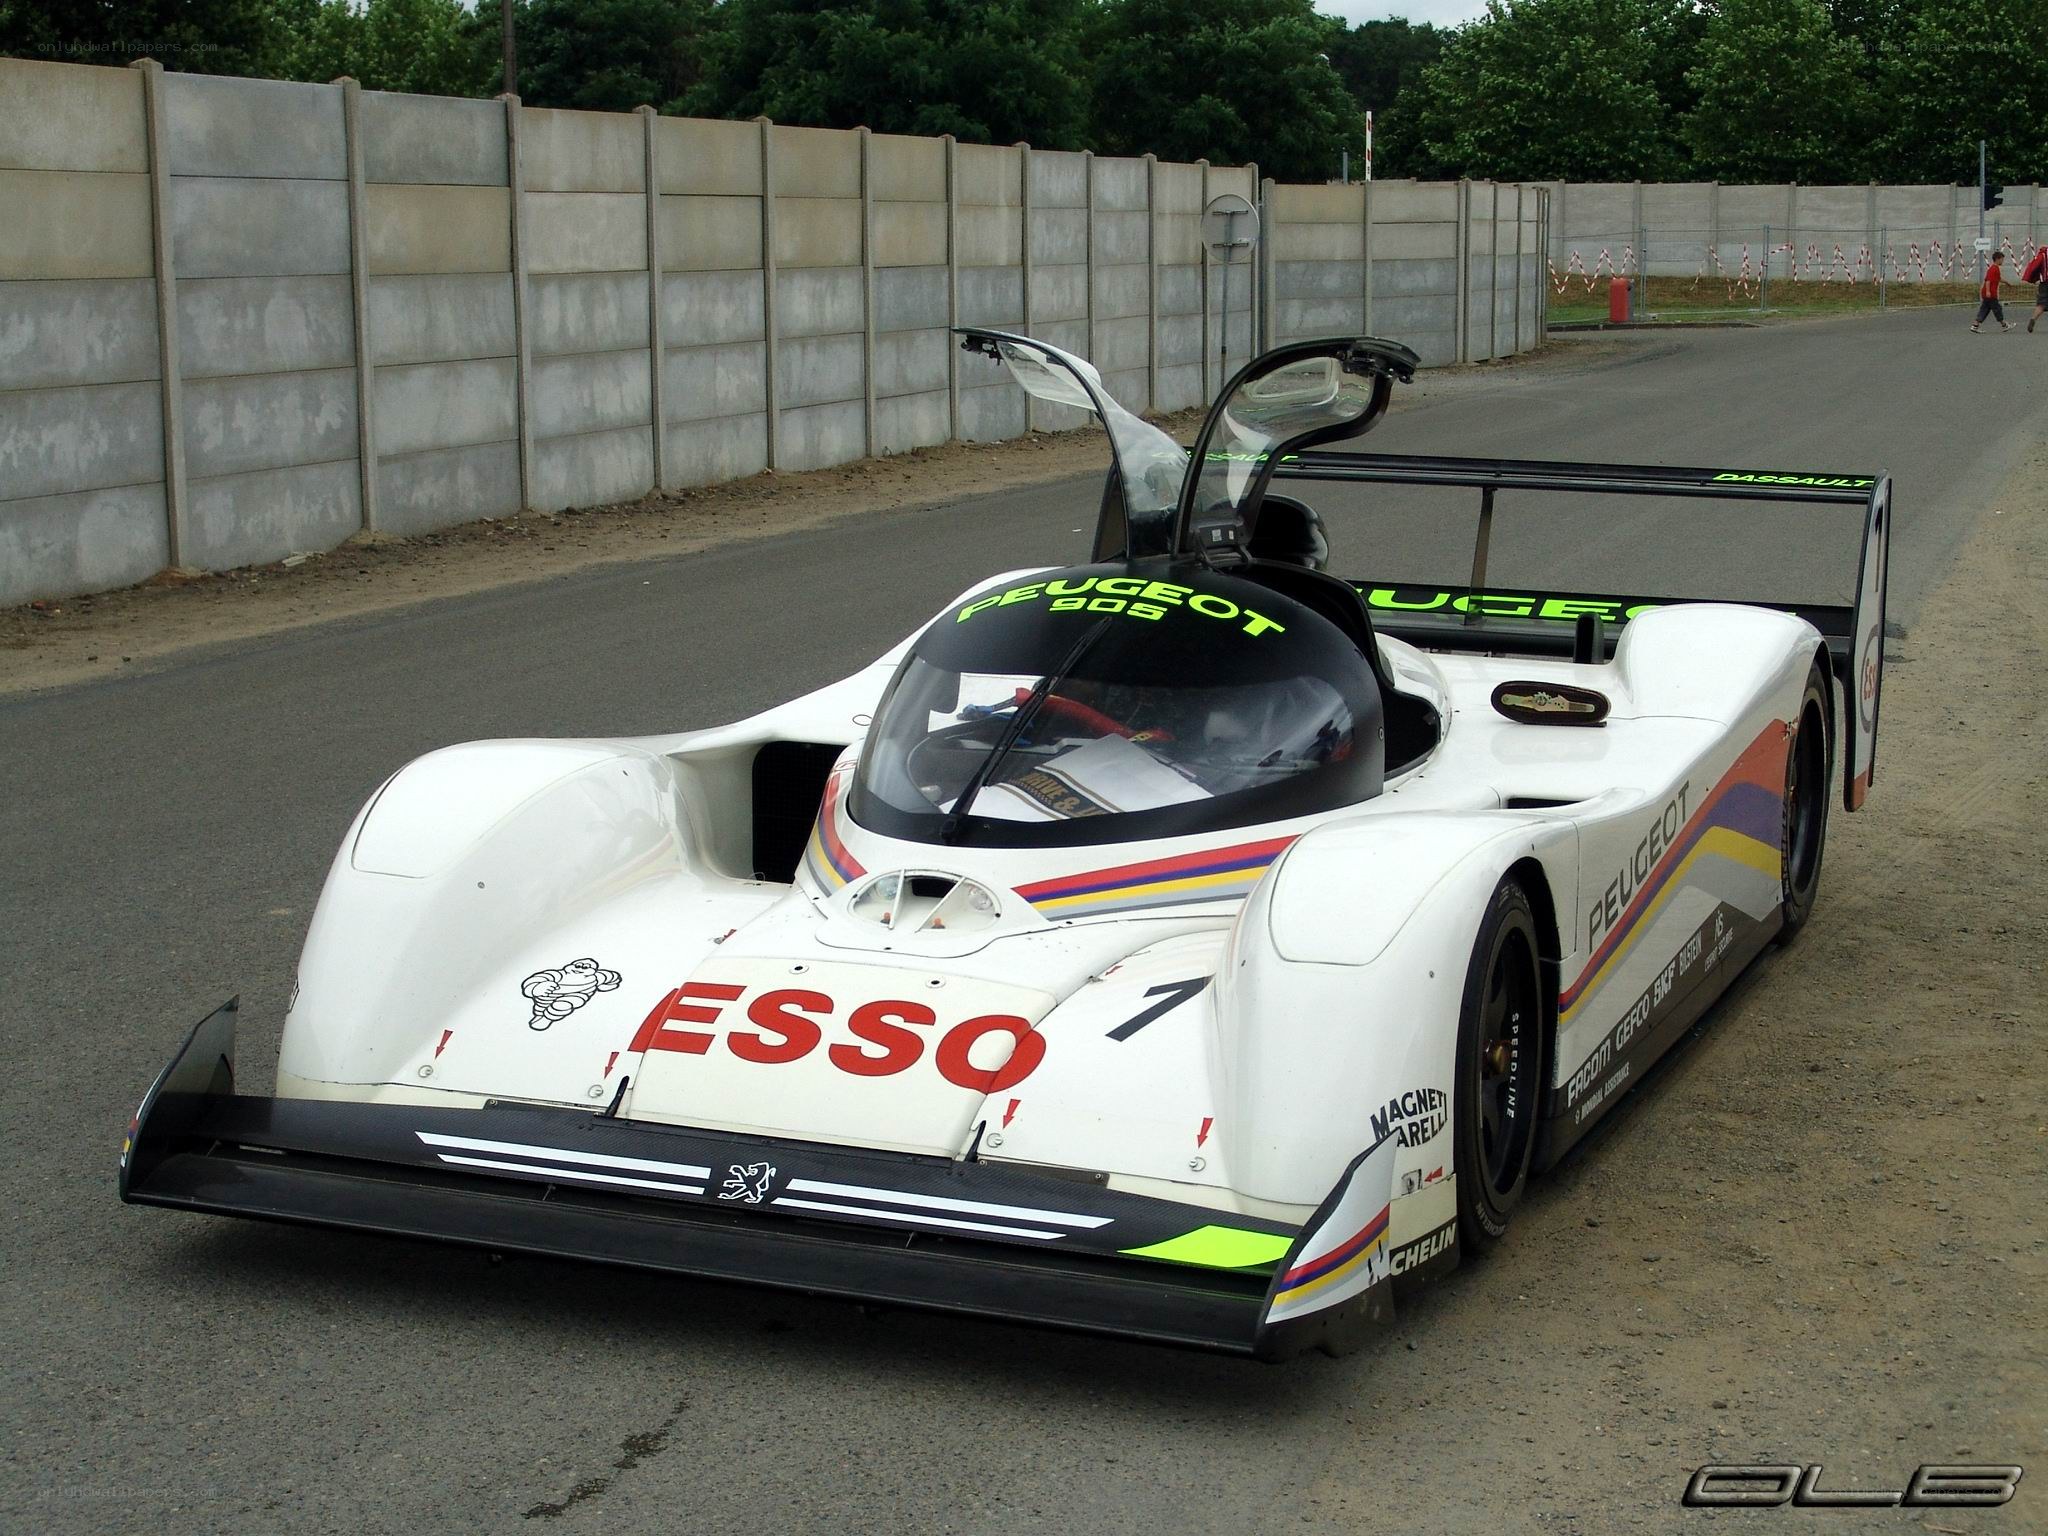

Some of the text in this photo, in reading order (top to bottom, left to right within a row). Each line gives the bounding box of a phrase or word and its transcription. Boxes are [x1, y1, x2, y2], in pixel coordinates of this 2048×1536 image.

[1712, 473, 1875, 487] DASSAULT
[956, 577, 1286, 637] PEUGEOT
[1049, 597, 1168, 621] 905
[1588, 779, 1690, 954] PEUGEOT
[627, 981, 1047, 1095] ESSO
[1506, 1012, 1519, 1119] SPEEDLINE
[1567, 1038, 1611, 1108] FACOM
[1615, 993, 1650, 1051] GEFCO
[1653, 960, 1676, 1008] SKF
[1370, 1088, 1448, 1143] MAGNETI
